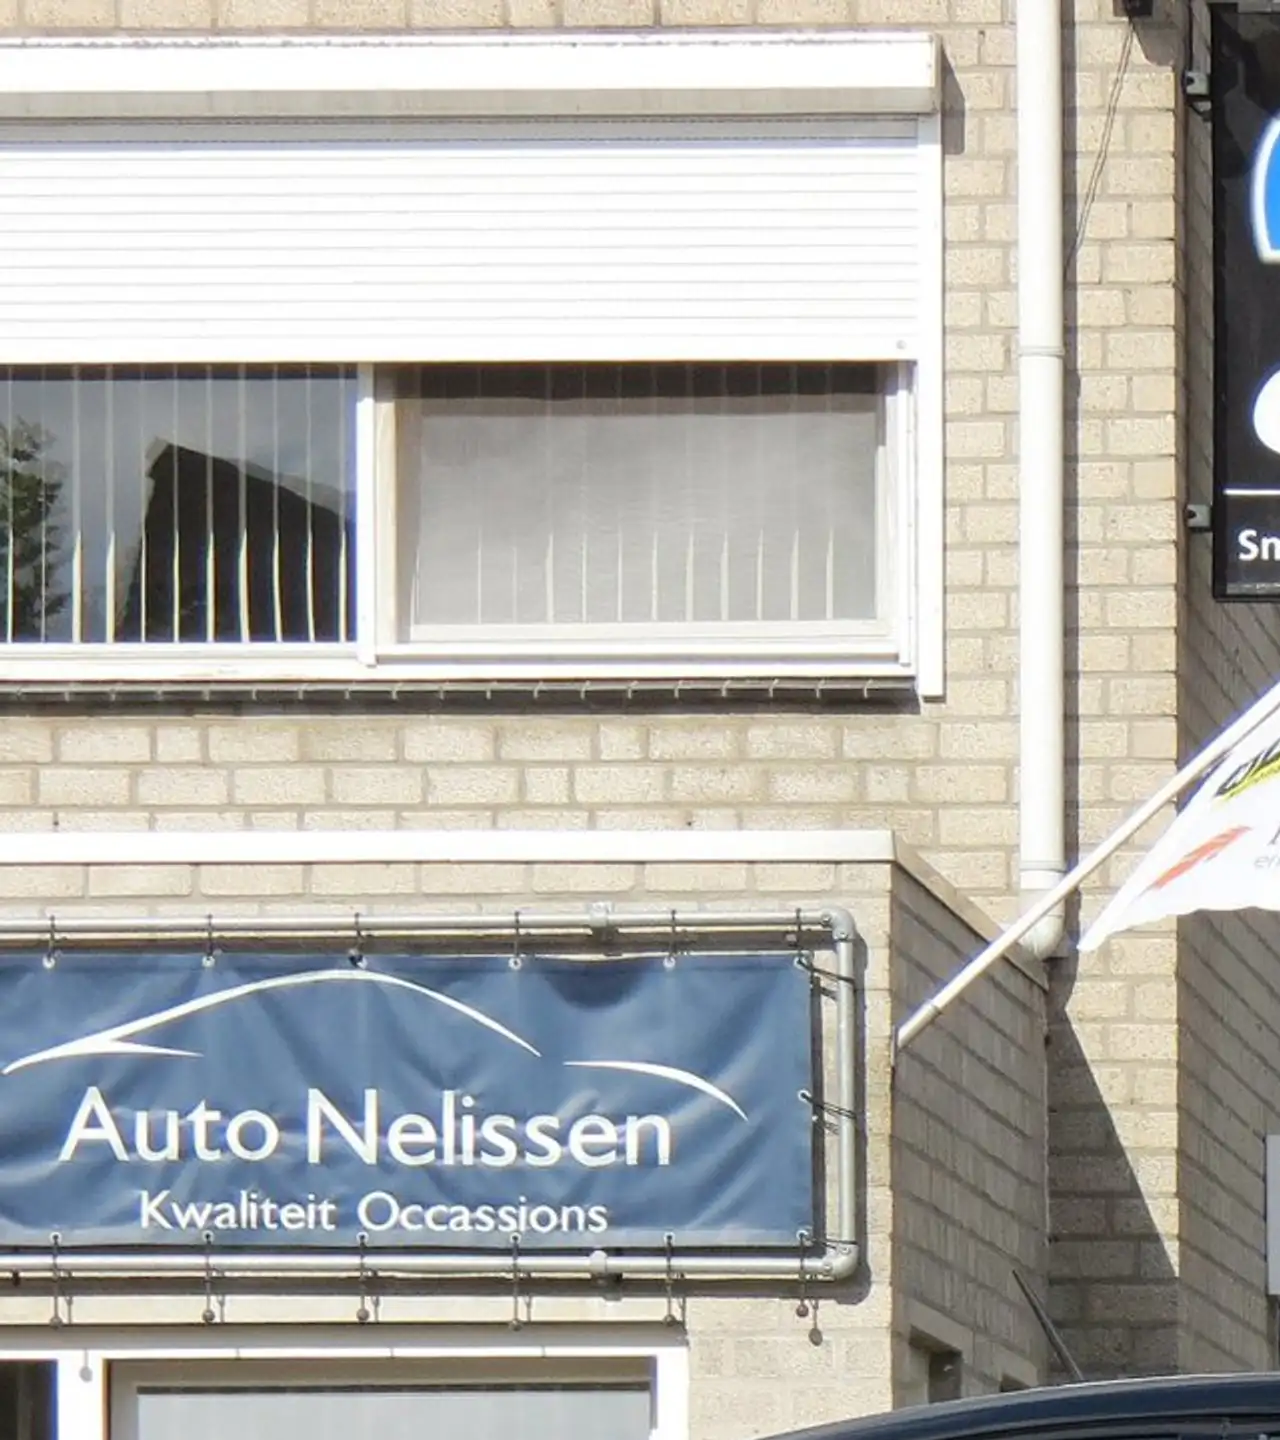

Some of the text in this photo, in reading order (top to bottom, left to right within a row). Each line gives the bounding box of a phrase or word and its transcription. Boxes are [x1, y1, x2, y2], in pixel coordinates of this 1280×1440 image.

[58, 1086, 671, 1166] Auto Nelissen
[139, 1190, 608, 1233] Kwaliteit Occassions
